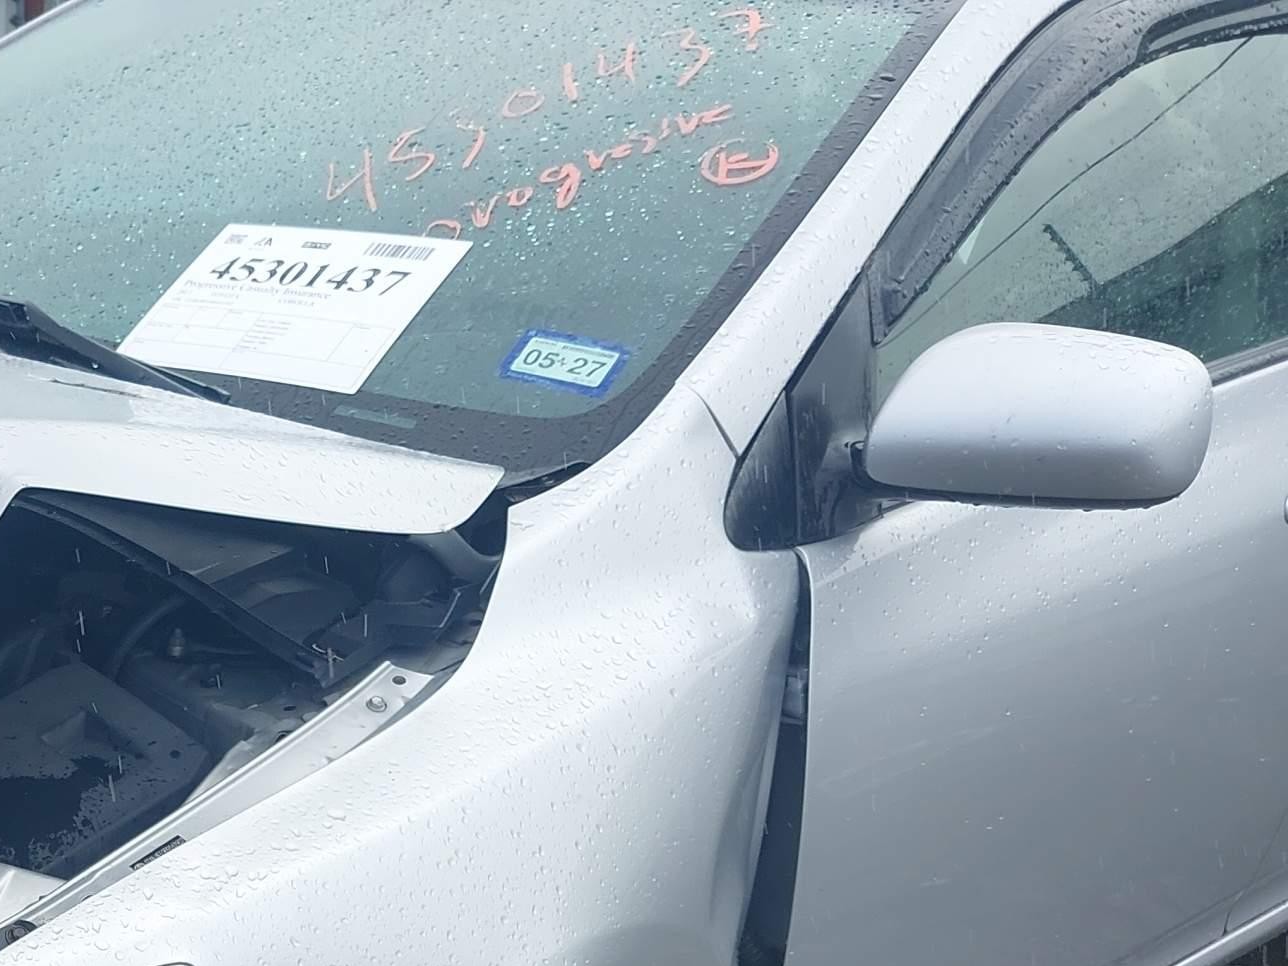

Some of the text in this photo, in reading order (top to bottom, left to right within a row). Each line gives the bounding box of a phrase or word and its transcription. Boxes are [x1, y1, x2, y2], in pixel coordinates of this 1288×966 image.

[209, 256, 413, 296] 45301437
[523, 349, 608, 378] 05 27
